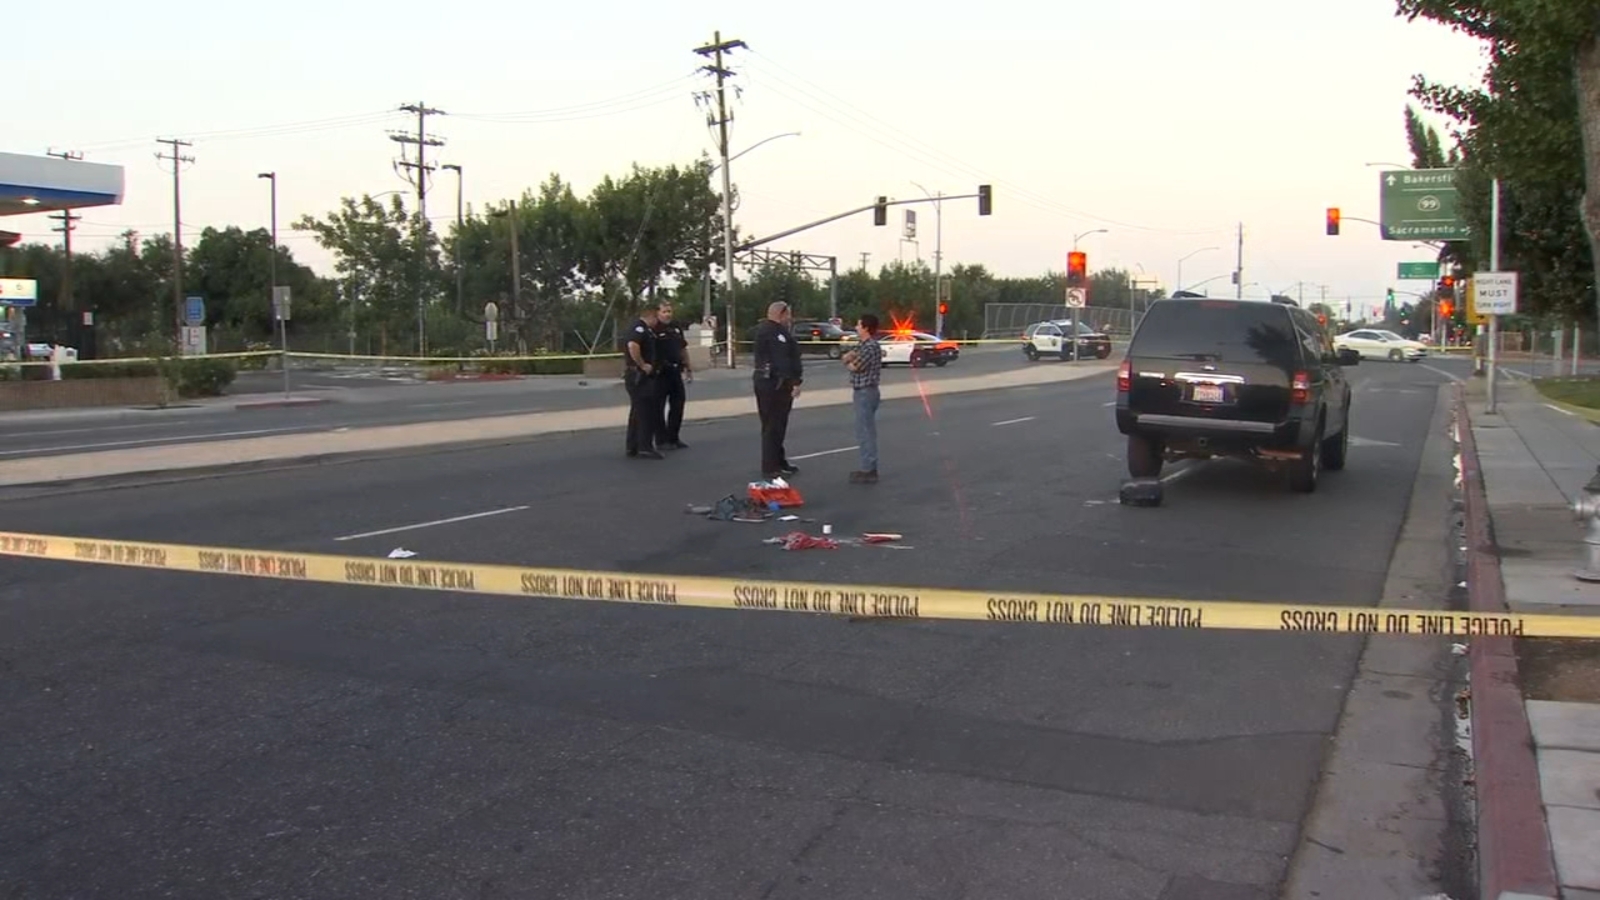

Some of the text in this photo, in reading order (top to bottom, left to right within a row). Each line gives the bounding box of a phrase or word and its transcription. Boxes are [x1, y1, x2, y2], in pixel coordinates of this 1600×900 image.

[1403, 174, 1452, 183] Bakersfi
[1421, 200, 1436, 209] 99
[1388, 225, 1456, 235] Sacramento
[198, 551, 306, 578] POLICE LINE DO NOT CROSS
[344, 561, 475, 590] POLICE LINE DO NOT CROSS
[520, 572, 677, 603] POLICE LINE DO NOT CROSS
[734, 585, 919, 617] POLICE LINE DO NOT CROSS
[986, 597, 1202, 628] POLICE LINE DO NOT CROSS
[1280, 609, 1523, 637] POLICE LINE DO NOT CROSS
